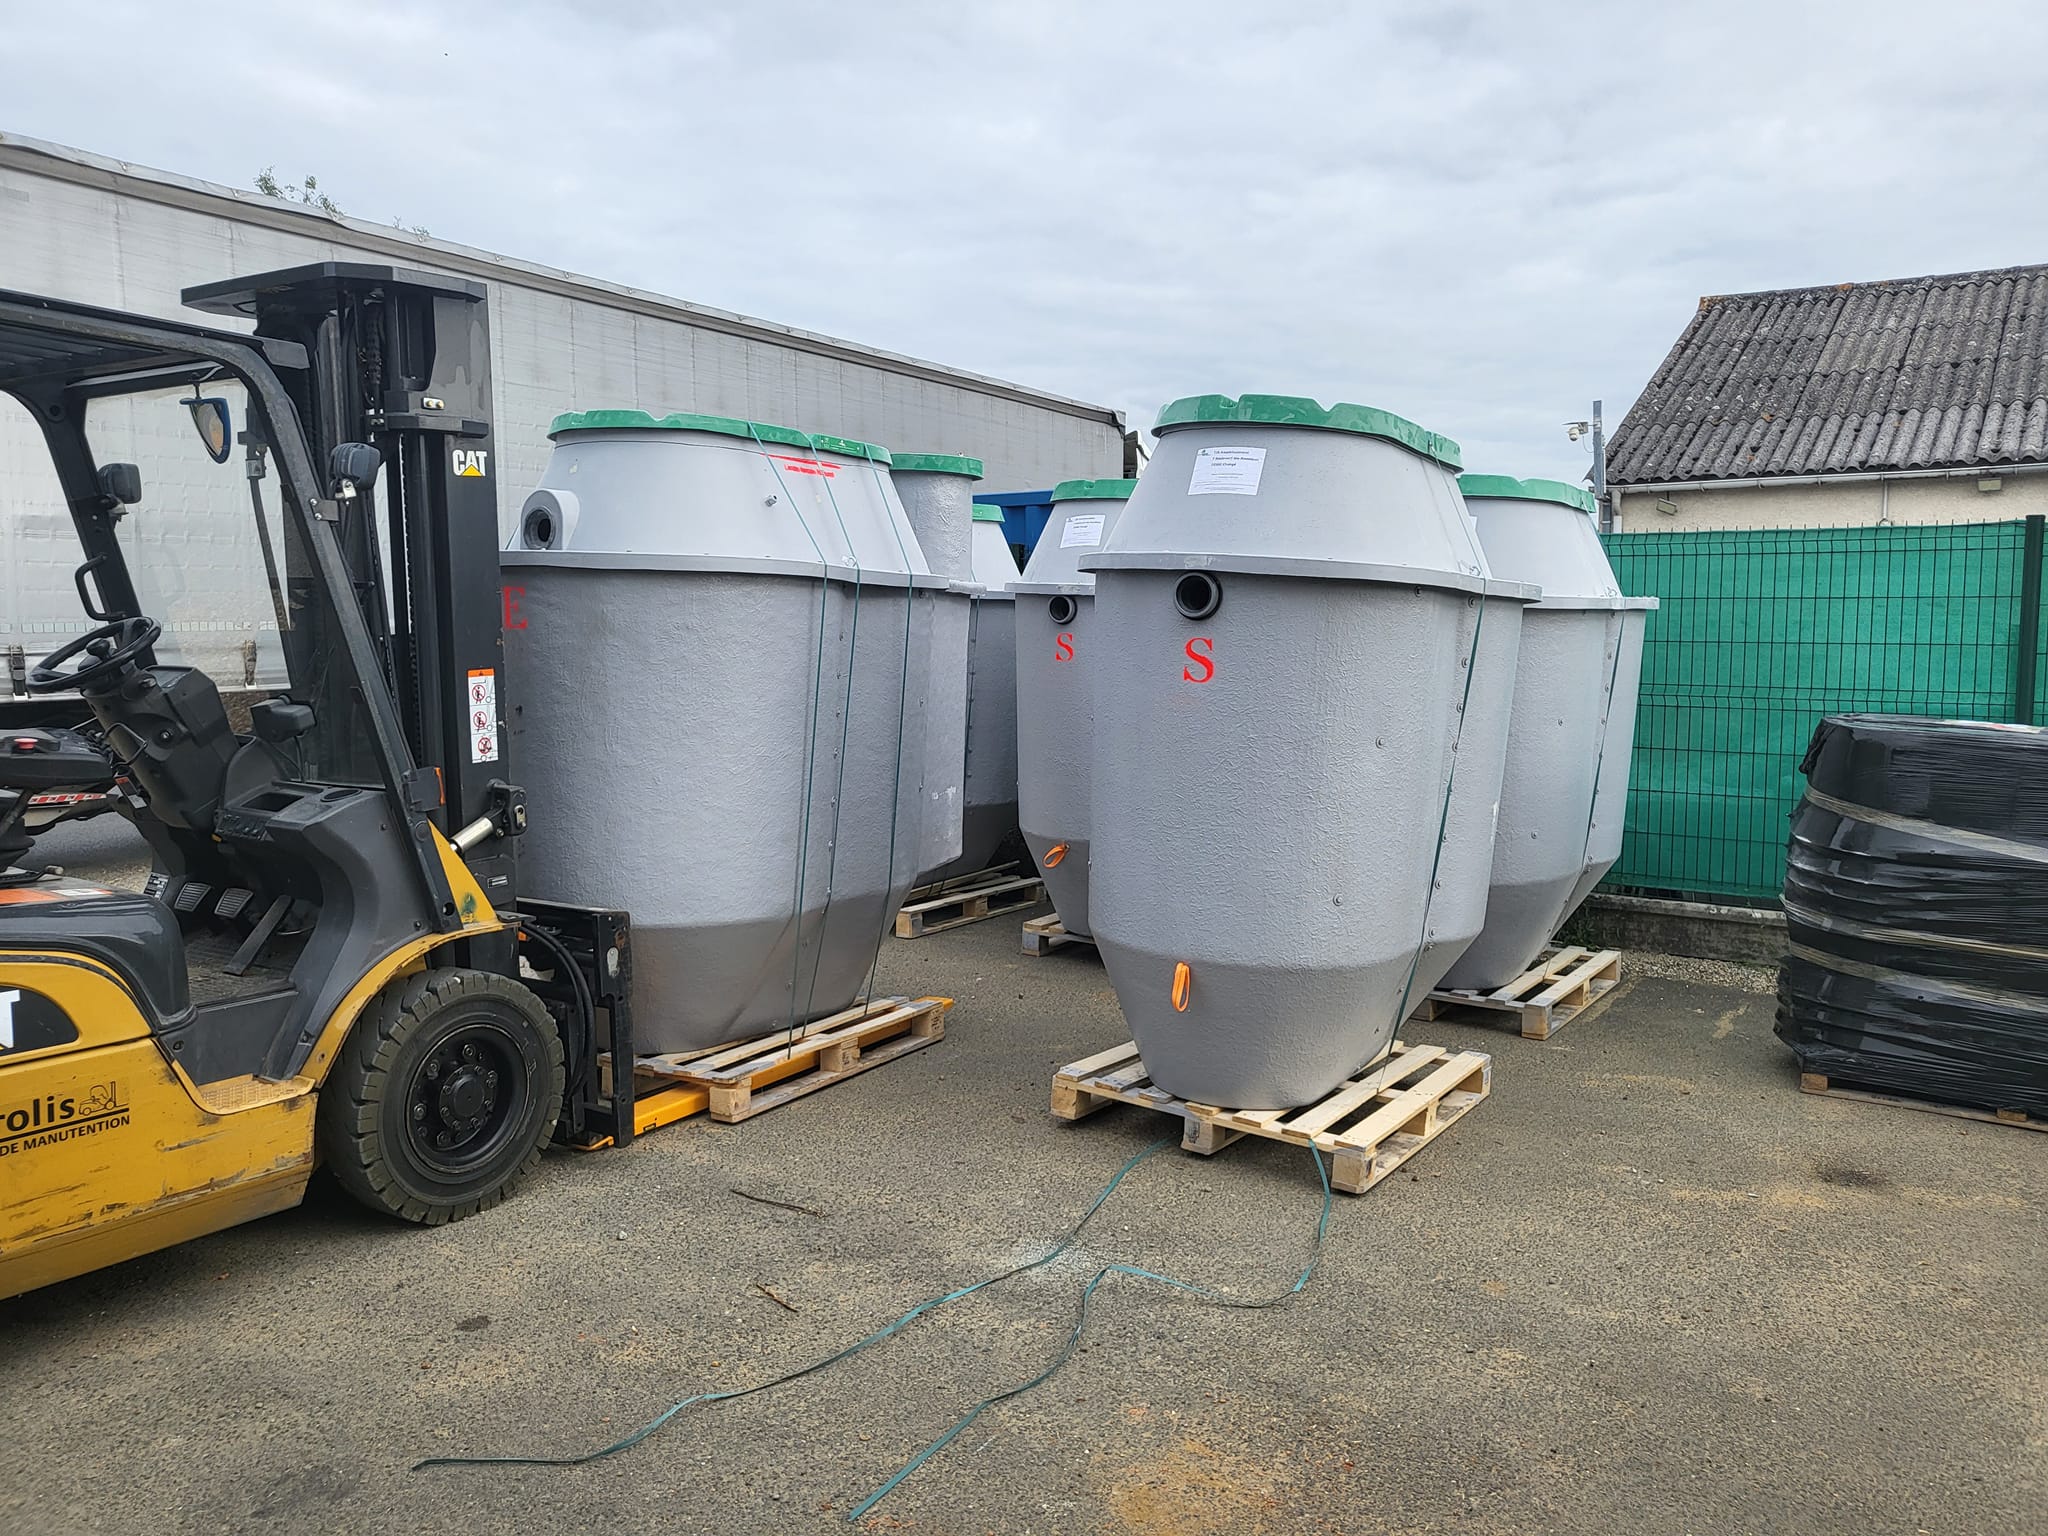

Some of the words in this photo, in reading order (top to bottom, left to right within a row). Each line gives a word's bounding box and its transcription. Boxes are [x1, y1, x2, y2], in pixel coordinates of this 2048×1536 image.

[452, 449, 487, 477] CAT
[503, 586, 528, 630] E
[1055, 632, 1074, 662] S
[1183, 637, 1214, 683] S
[0, 1095, 75, 1132] olis
[0, 1142, 19, 1157] DE
[23, 1115, 130, 1150] MANUTENTION
